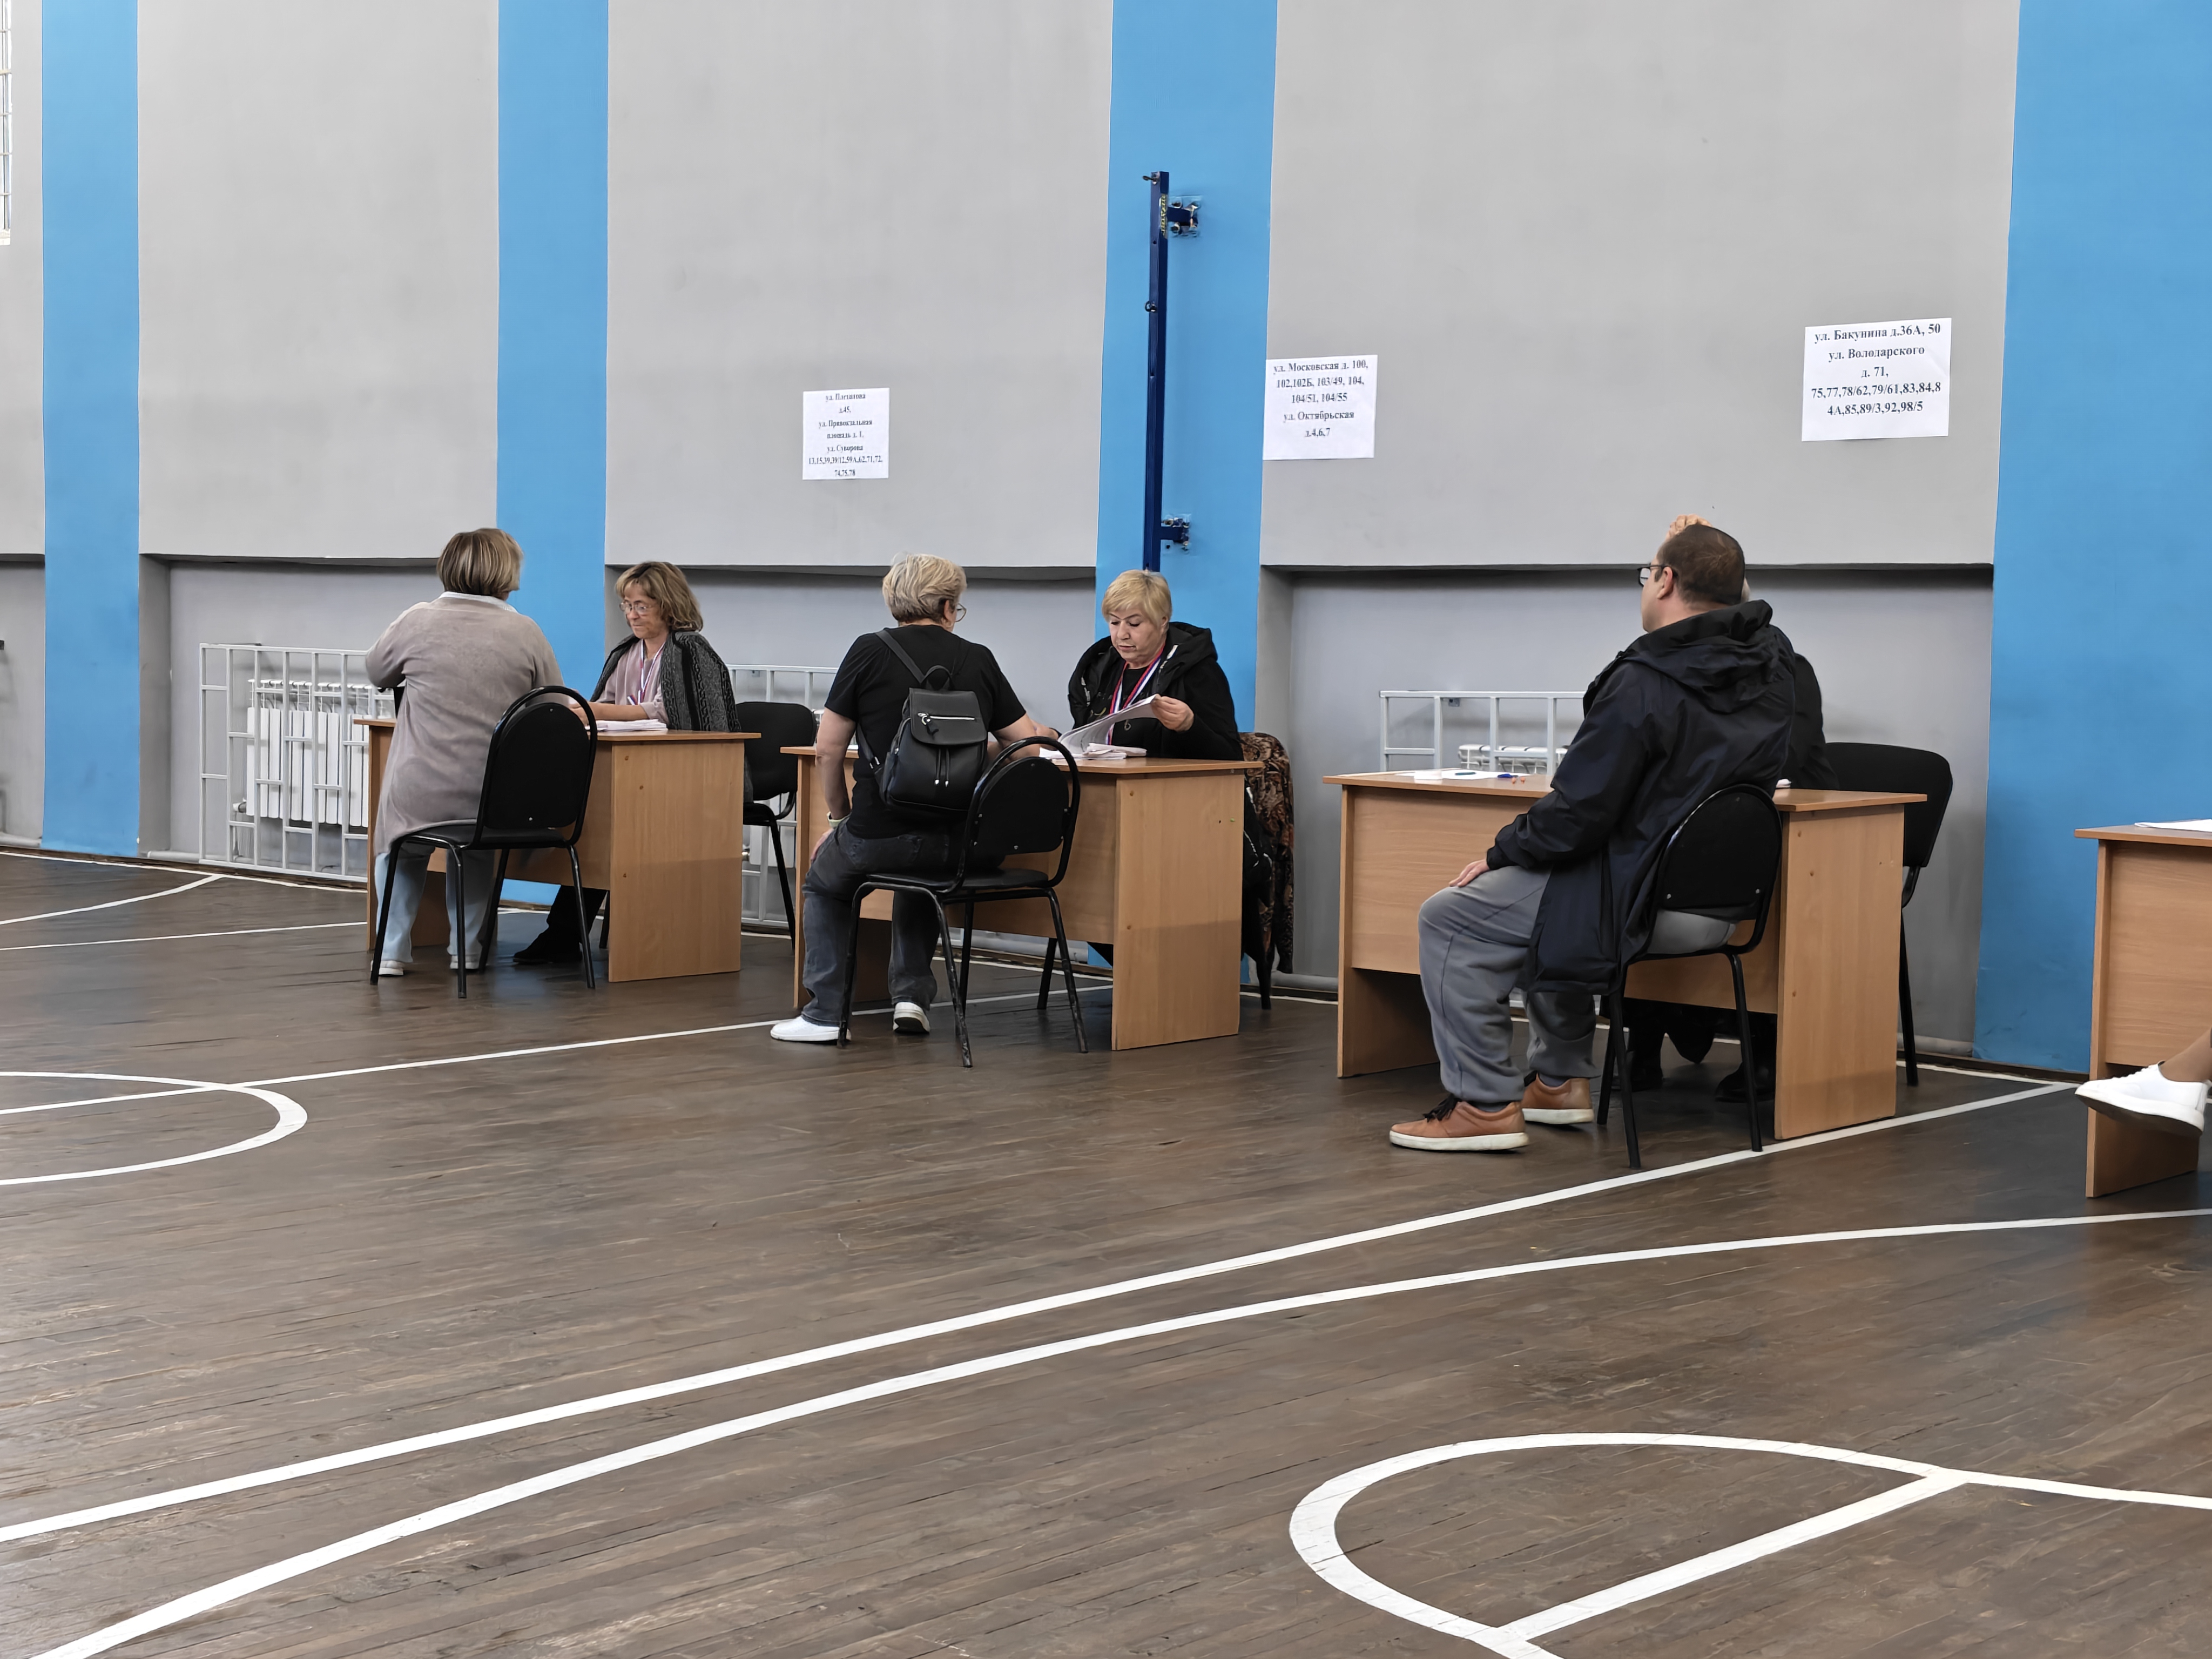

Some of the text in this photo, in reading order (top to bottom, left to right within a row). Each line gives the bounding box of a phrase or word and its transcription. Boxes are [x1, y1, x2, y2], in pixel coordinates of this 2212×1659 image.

[1815, 323, 1940, 344] ул. Бакунина д.36А, 50
[1829, 347, 1925, 362] ул. Володарского
[1273, 366, 1286, 375] ул.
[1288, 363, 1339, 372] Московская
[1353, 360, 1368, 369] 100,
[1874, 366, 1889, 377] 71,
[1277, 376, 1364, 388] 102,102Б, 103/49, 104,
[1811, 382, 1941, 399] 75,77,78/62,79/61,83,84,8
[1292, 393, 1347, 403] 104/51, 104/55
[1827, 401, 1923, 416] 4А,85,89/3,92,98/5
[1297, 410, 1354, 422] Октябрьская
[837, 444, 863, 453] Суворова
